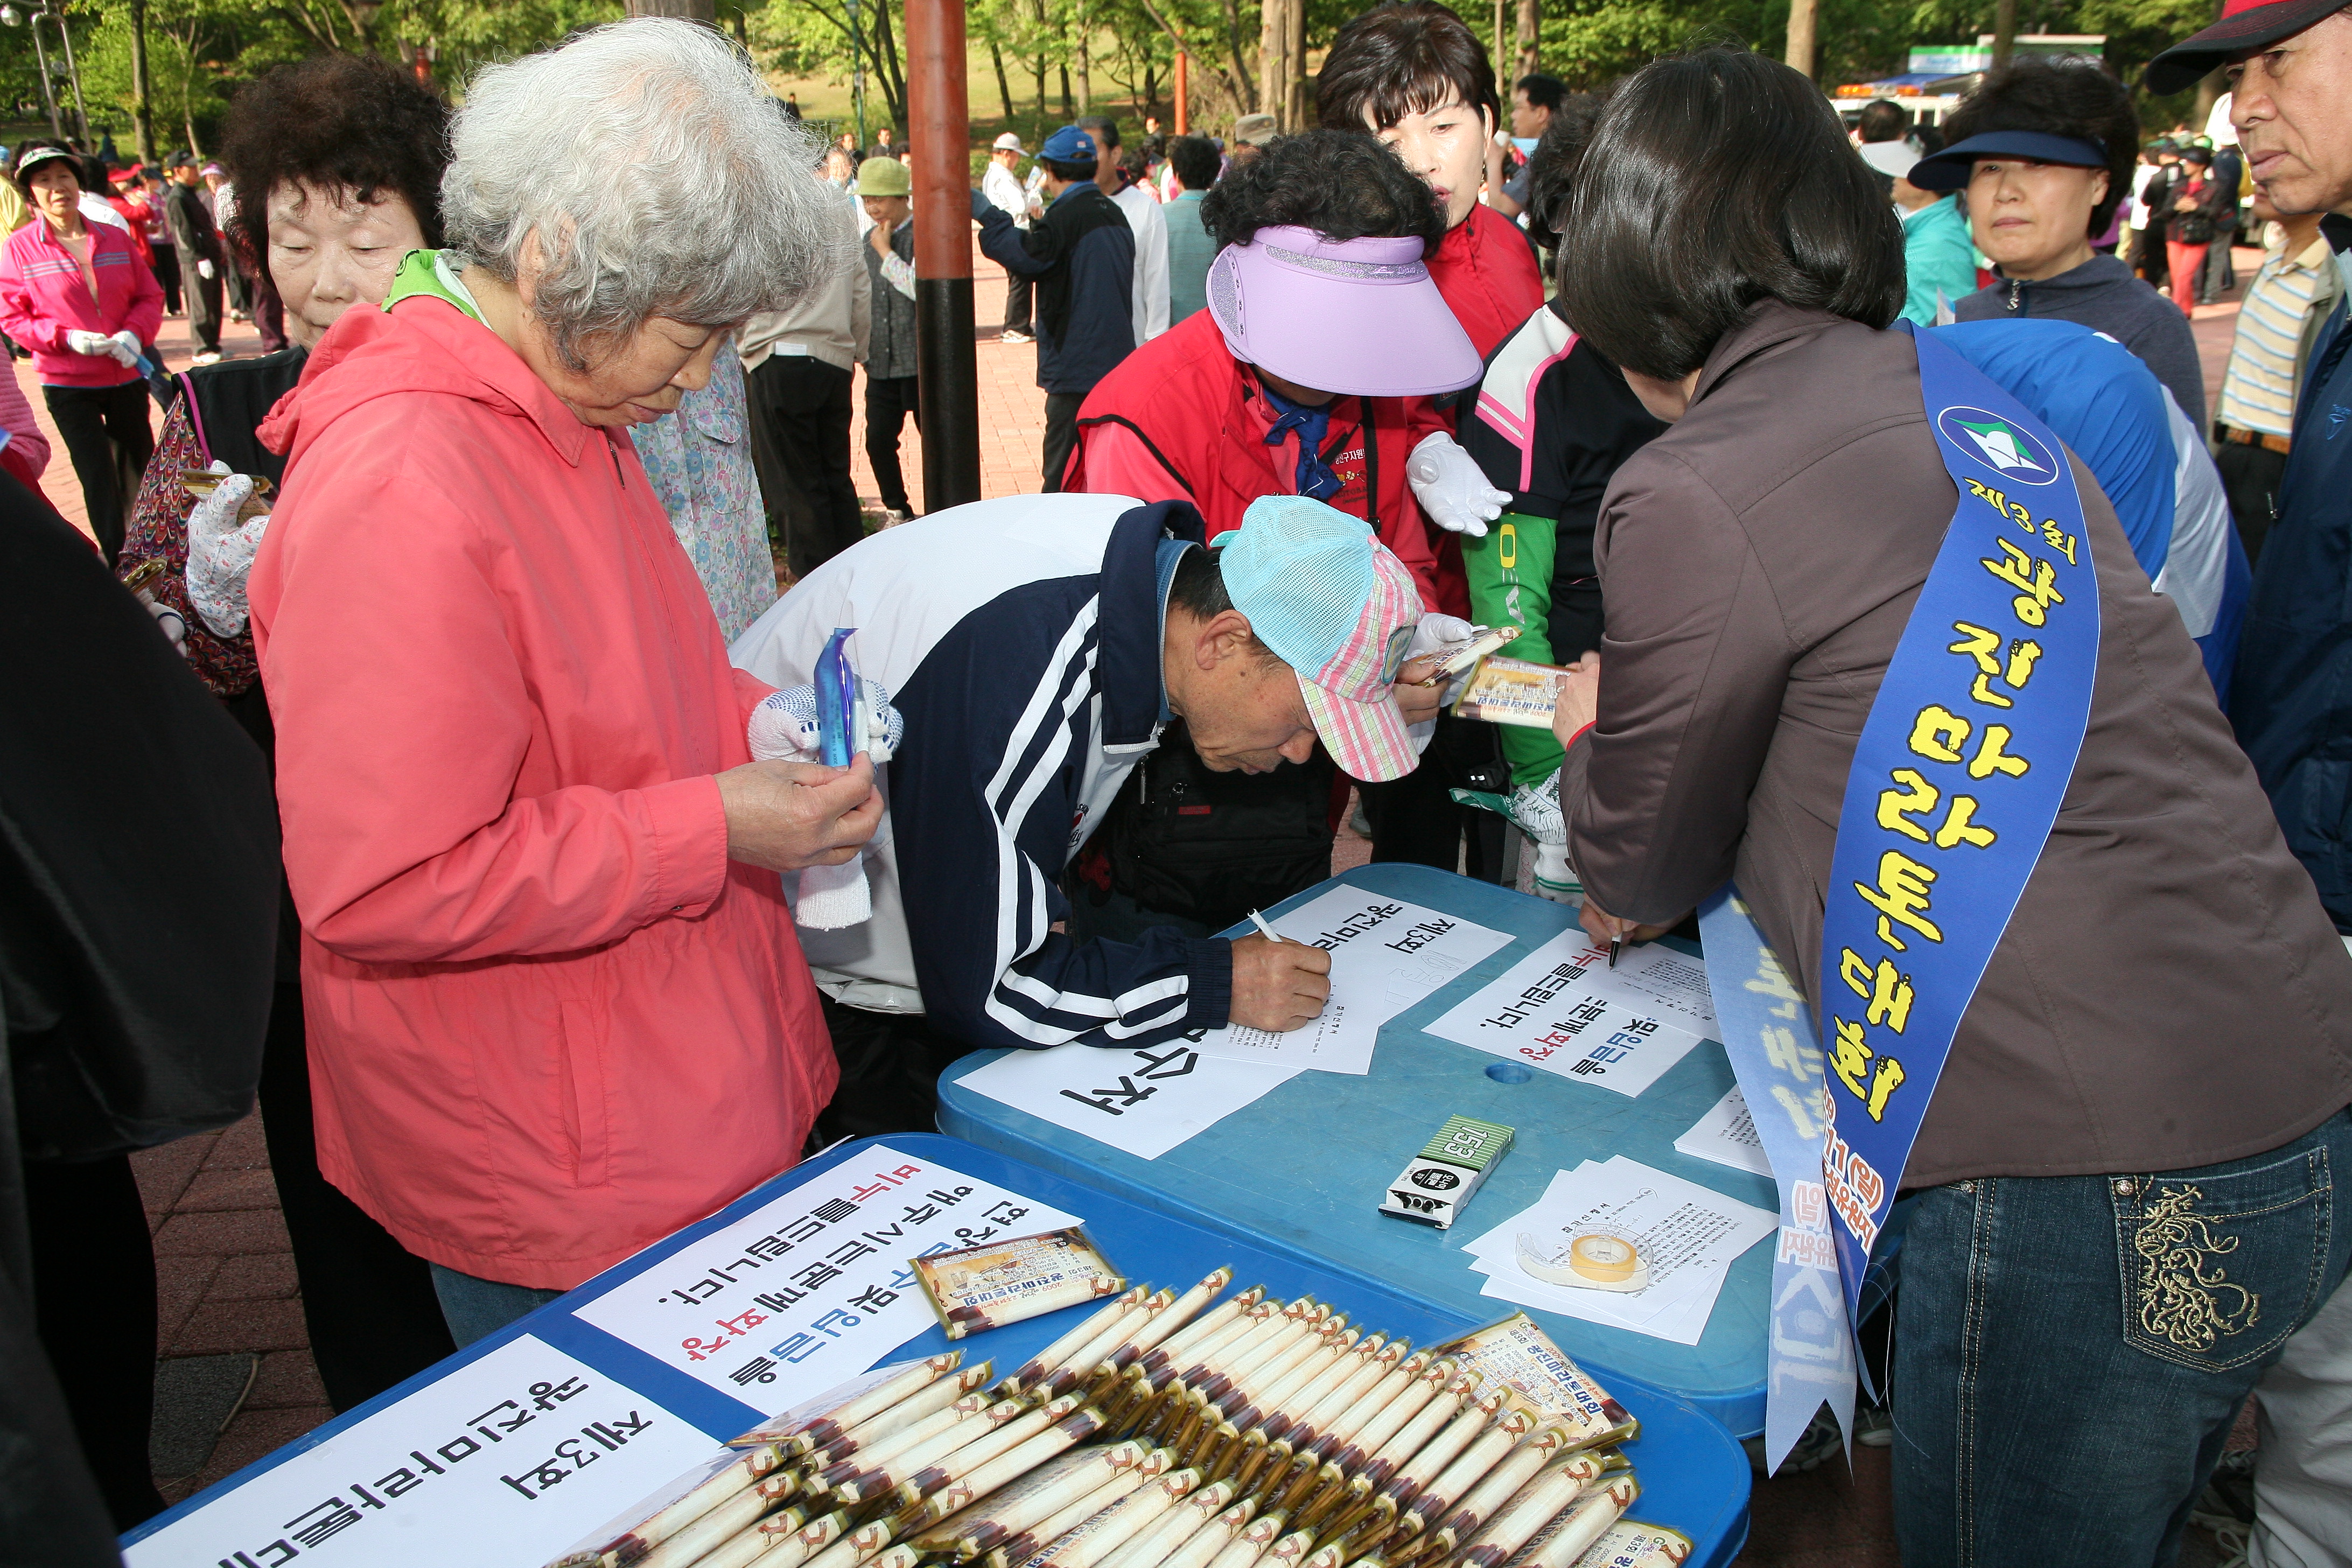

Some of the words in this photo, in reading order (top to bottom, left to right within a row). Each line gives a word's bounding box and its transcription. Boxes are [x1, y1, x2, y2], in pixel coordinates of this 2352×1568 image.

[1962, 477, 2076, 566] 제3회
[1826, 536, 2066, 1122] 광진마라톤대회
[1383, 919, 1455, 954] 제3회
[1441, 1125, 1489, 1159] 153
[1423, 1172, 1443, 1185] 볼펜
[1434, 1173, 1454, 1189] 모나미
[657, 1163, 921, 1305] 비누를드립니다.
[1041, 1282, 1062, 1291] 2009
[1068, 1264, 1092, 1275] 제3회
[962, 1271, 1065, 1307] 광진마라톤대회
[1545, 1344, 1563, 1362] 2009
[1508, 1326, 1529, 1347] 제3회
[1524, 1340, 1604, 1418] 광진마라톤대회
[500, 1410, 652, 1499] 제3회
[1624, 1533, 1647, 1553] 제3회
